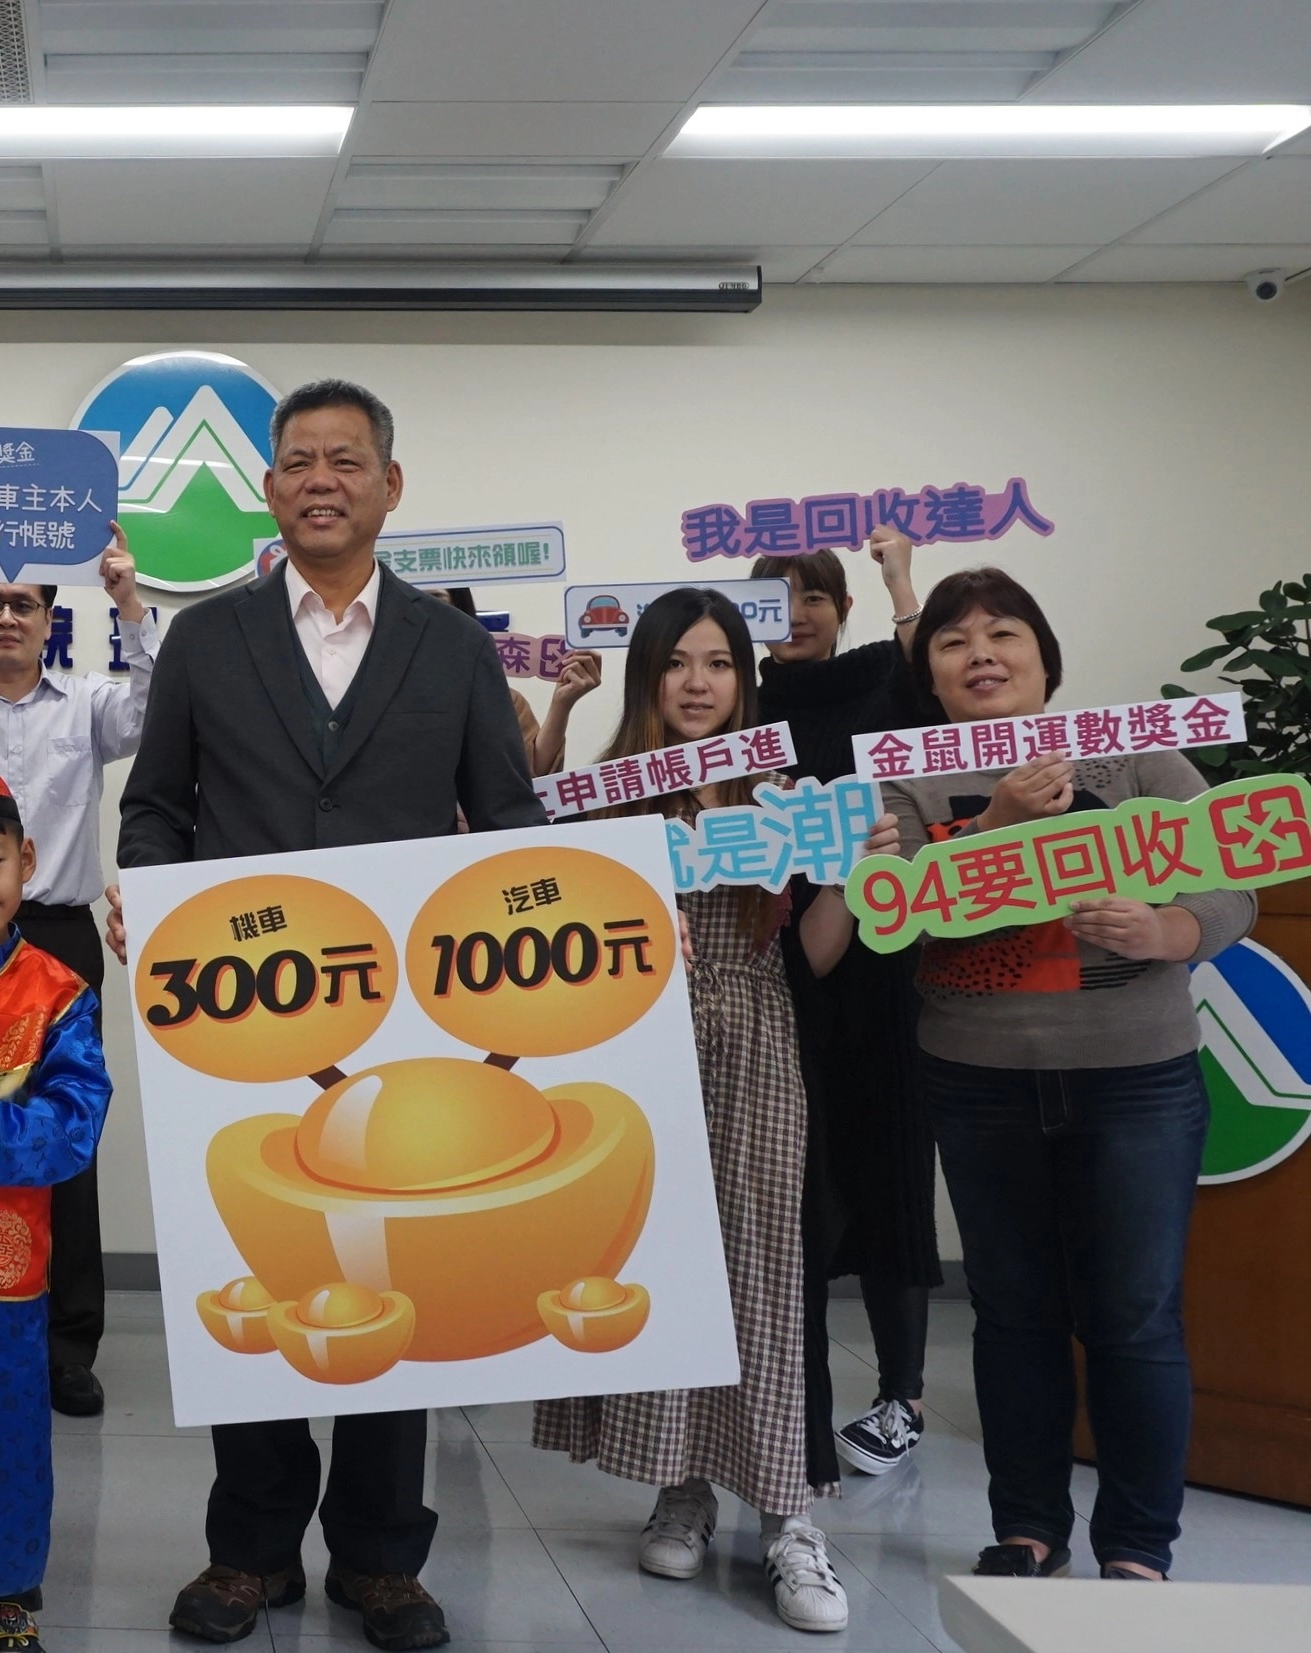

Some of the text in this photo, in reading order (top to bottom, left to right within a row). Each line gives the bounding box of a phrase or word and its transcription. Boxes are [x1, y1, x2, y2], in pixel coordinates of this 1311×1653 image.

[684, 482, 1051, 558] 我是回收達人
[868, 697, 1232, 779] 金鼠開運數獎金
[501, 877, 562, 915] 汽車
[863, 810, 1203, 936] 94要回收
[229, 905, 288, 942] 機車
[431, 918, 655, 996] 1000元
[147, 943, 382, 1027] 300元
